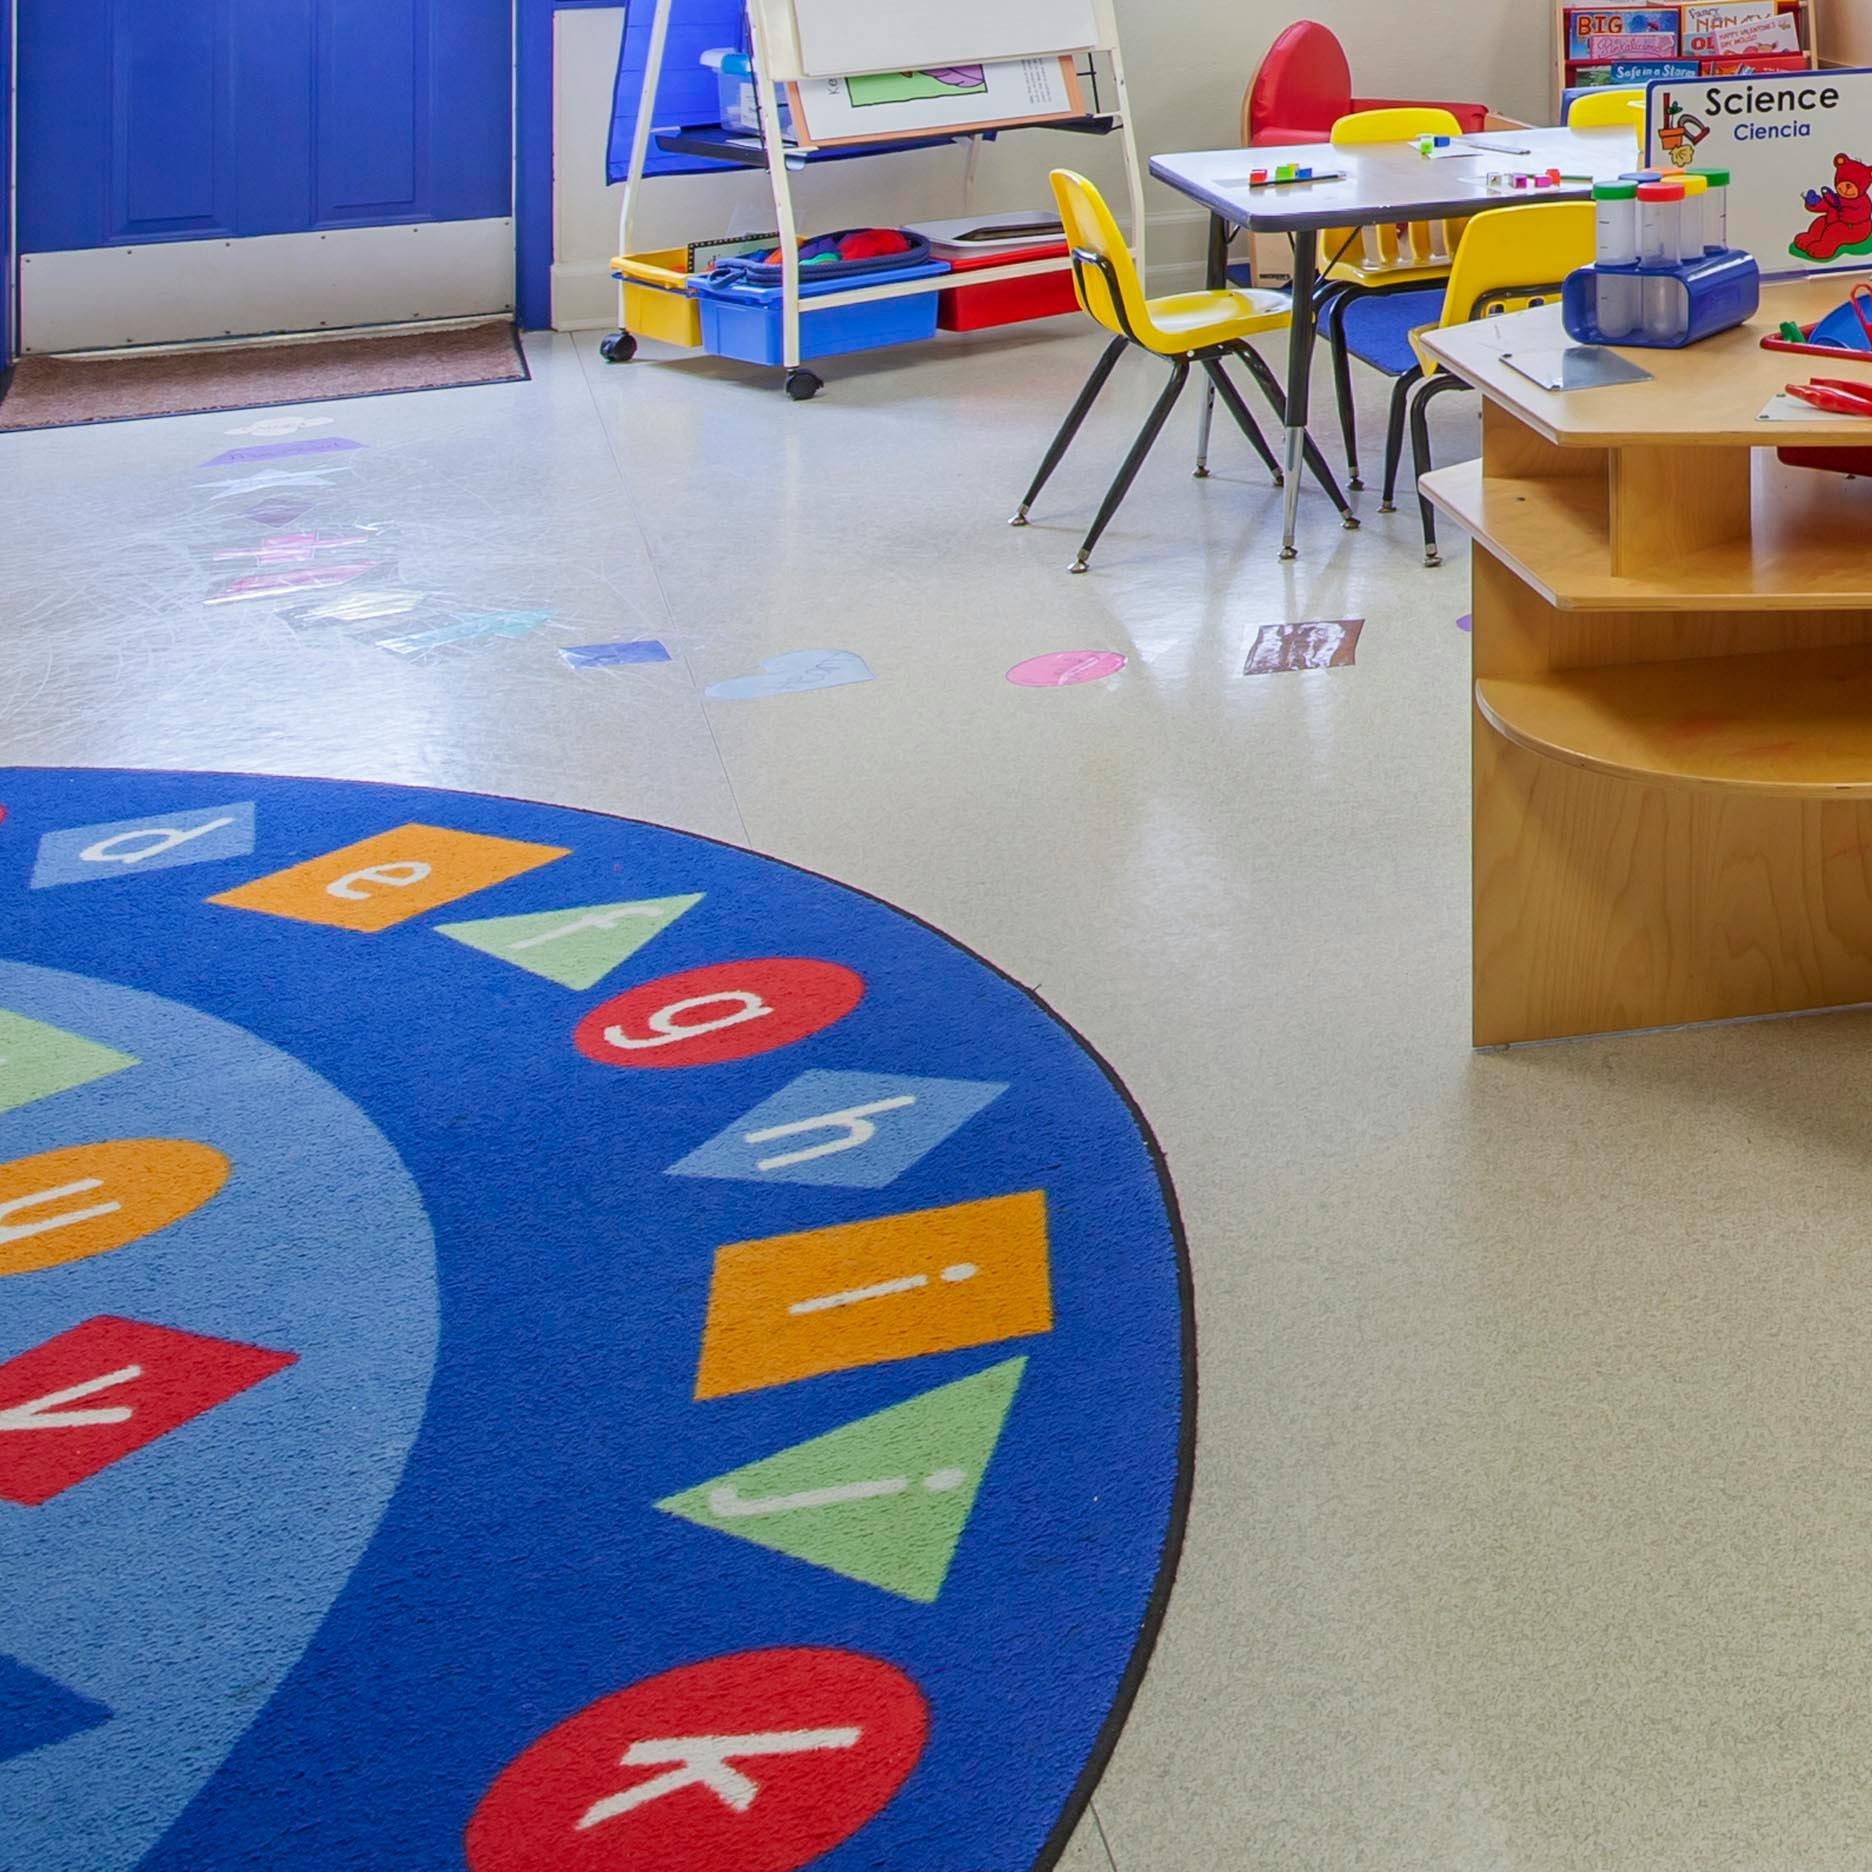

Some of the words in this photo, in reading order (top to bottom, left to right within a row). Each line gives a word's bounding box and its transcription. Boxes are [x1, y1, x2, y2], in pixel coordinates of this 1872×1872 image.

[1577, 15, 1623, 37] BIG
[1616, 65, 1641, 79] Safe
[1643, 67, 1652, 77] in
[1653, 68, 1661, 76] a
[1662, 64, 1696, 78] Storm
[1706, 83, 1839, 117] Science
[1734, 120, 1811, 141] Ciencia
[79, 815, 235, 866] d
[327, 858, 432, 901] e
[508, 905, 662, 952] f
[604, 990, 771, 1050] g
[742, 1094, 915, 1172] h
[788, 1261, 978, 1318] i
[707, 1464, 966, 1517] j
